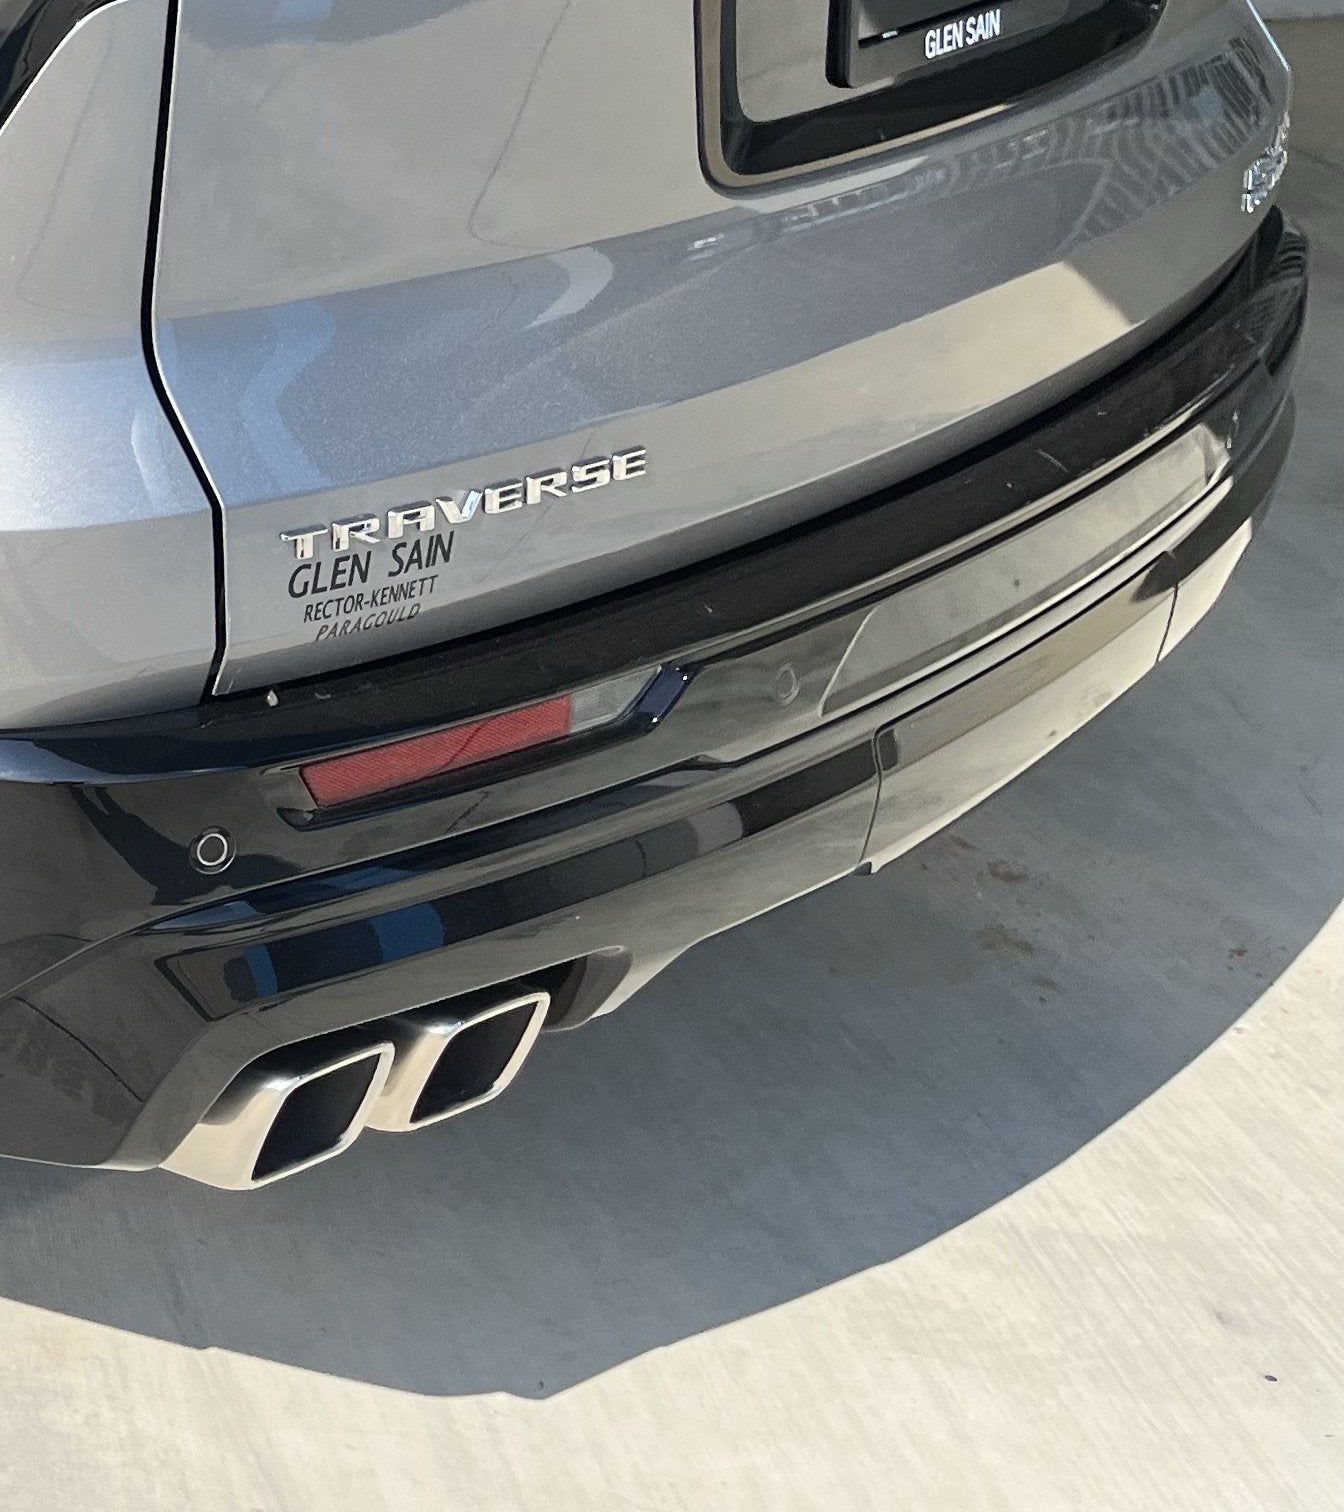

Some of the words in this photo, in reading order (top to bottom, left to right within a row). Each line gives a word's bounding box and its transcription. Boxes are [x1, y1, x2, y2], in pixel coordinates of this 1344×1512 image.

[924, 19, 964, 60] GLEN
[965, 8, 1001, 46] SAIN
[280, 445, 648, 560] TRAVERSE
[288, 551, 372, 599] GLEN
[388, 530, 454, 578] SAIN
[304, 574, 439, 623] RECTOR-KENNETT
[315, 603, 421, 642] PARAGOULD
